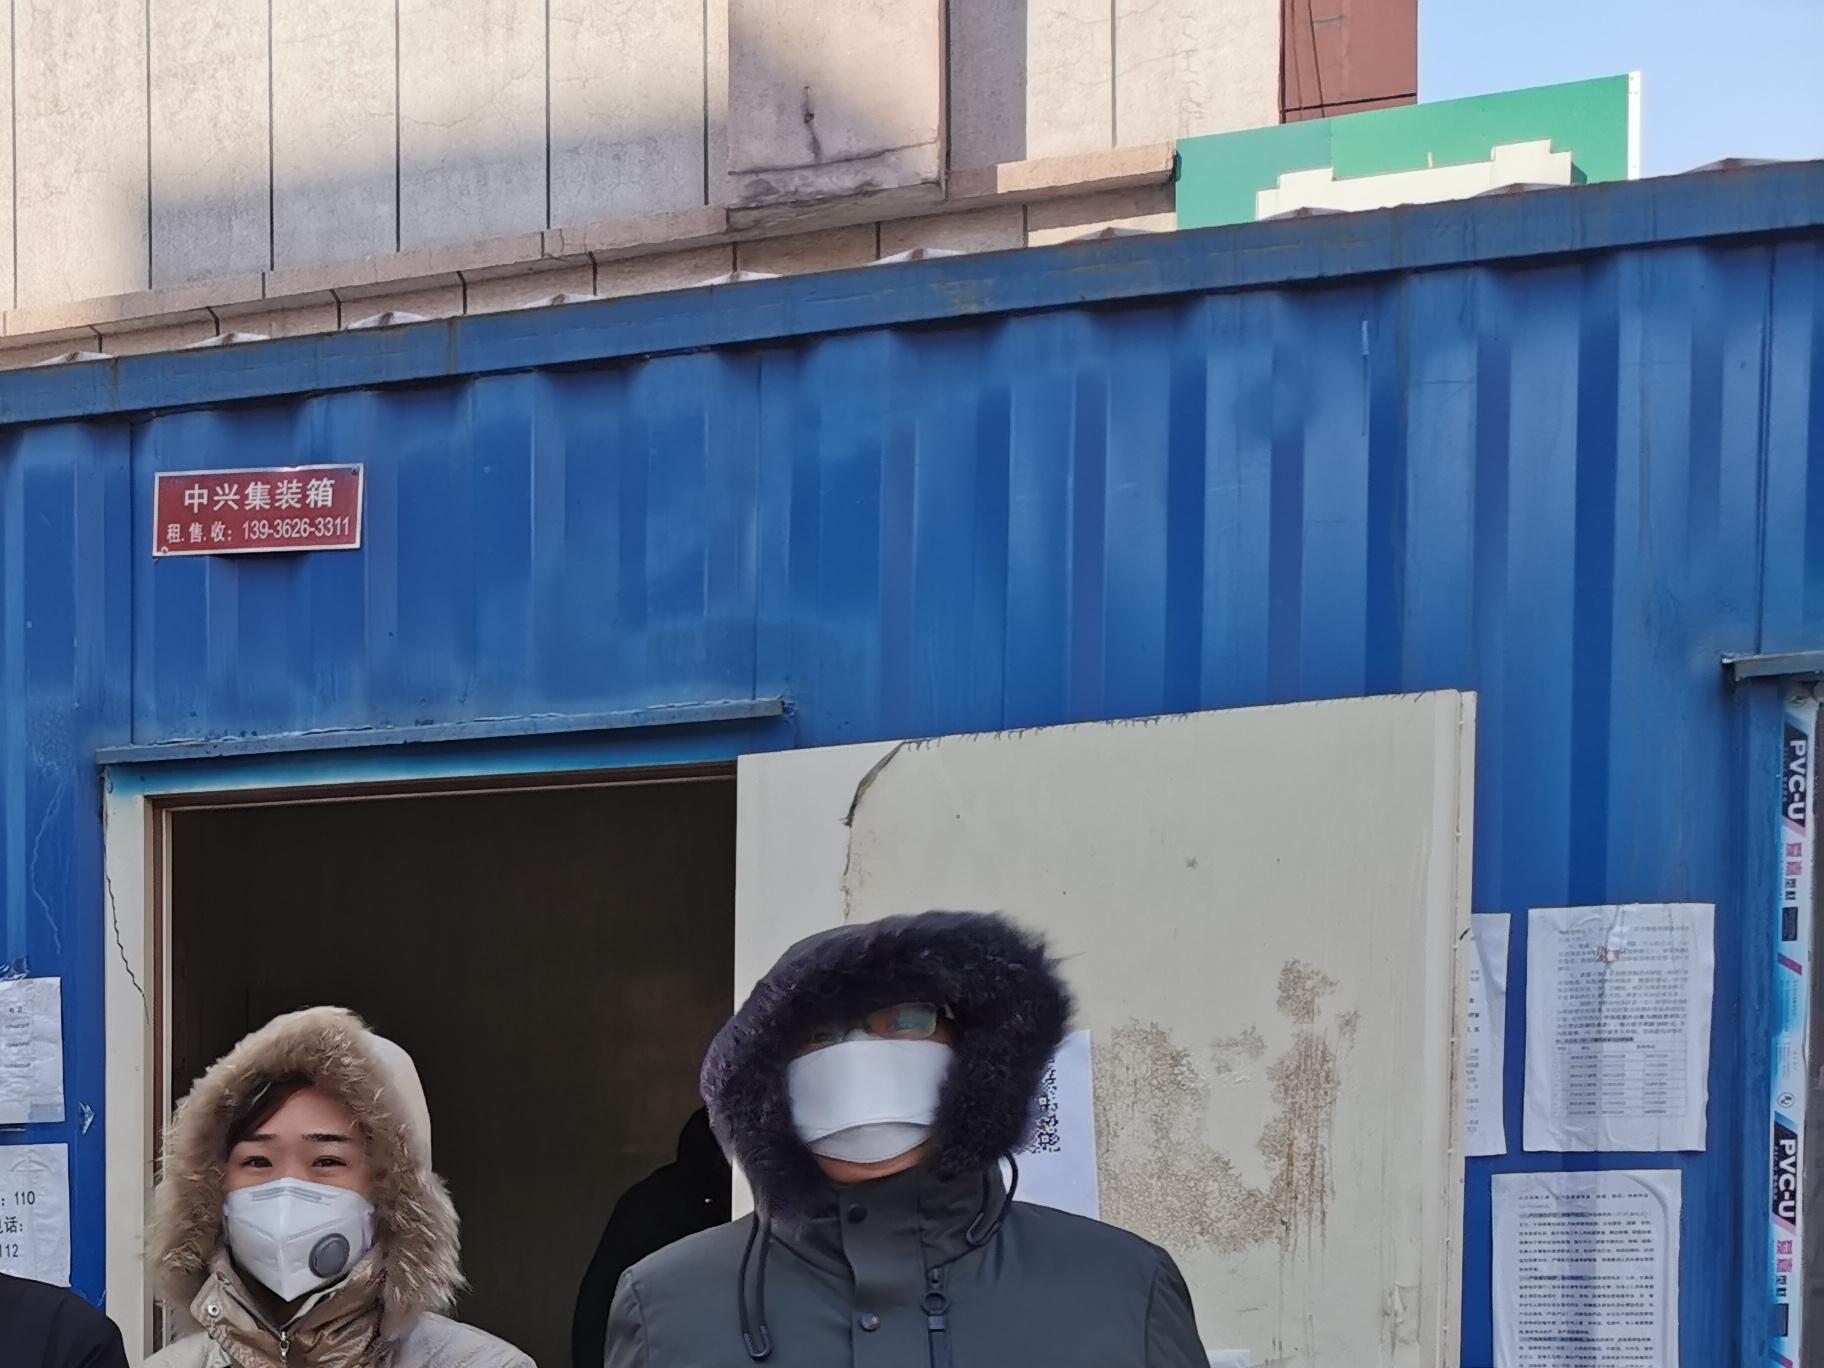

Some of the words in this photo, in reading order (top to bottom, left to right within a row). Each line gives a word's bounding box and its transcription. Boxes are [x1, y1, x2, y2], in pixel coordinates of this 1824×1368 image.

[183, 477, 336, 514] 中兴集装箱
[242, 516, 351, 541] 139-3626-3311
[1787, 739, 1807, 819] PVC-U
[1778, 1138, 1797, 1218] PVC-U
[14, 1190, 36, 1205] 110
